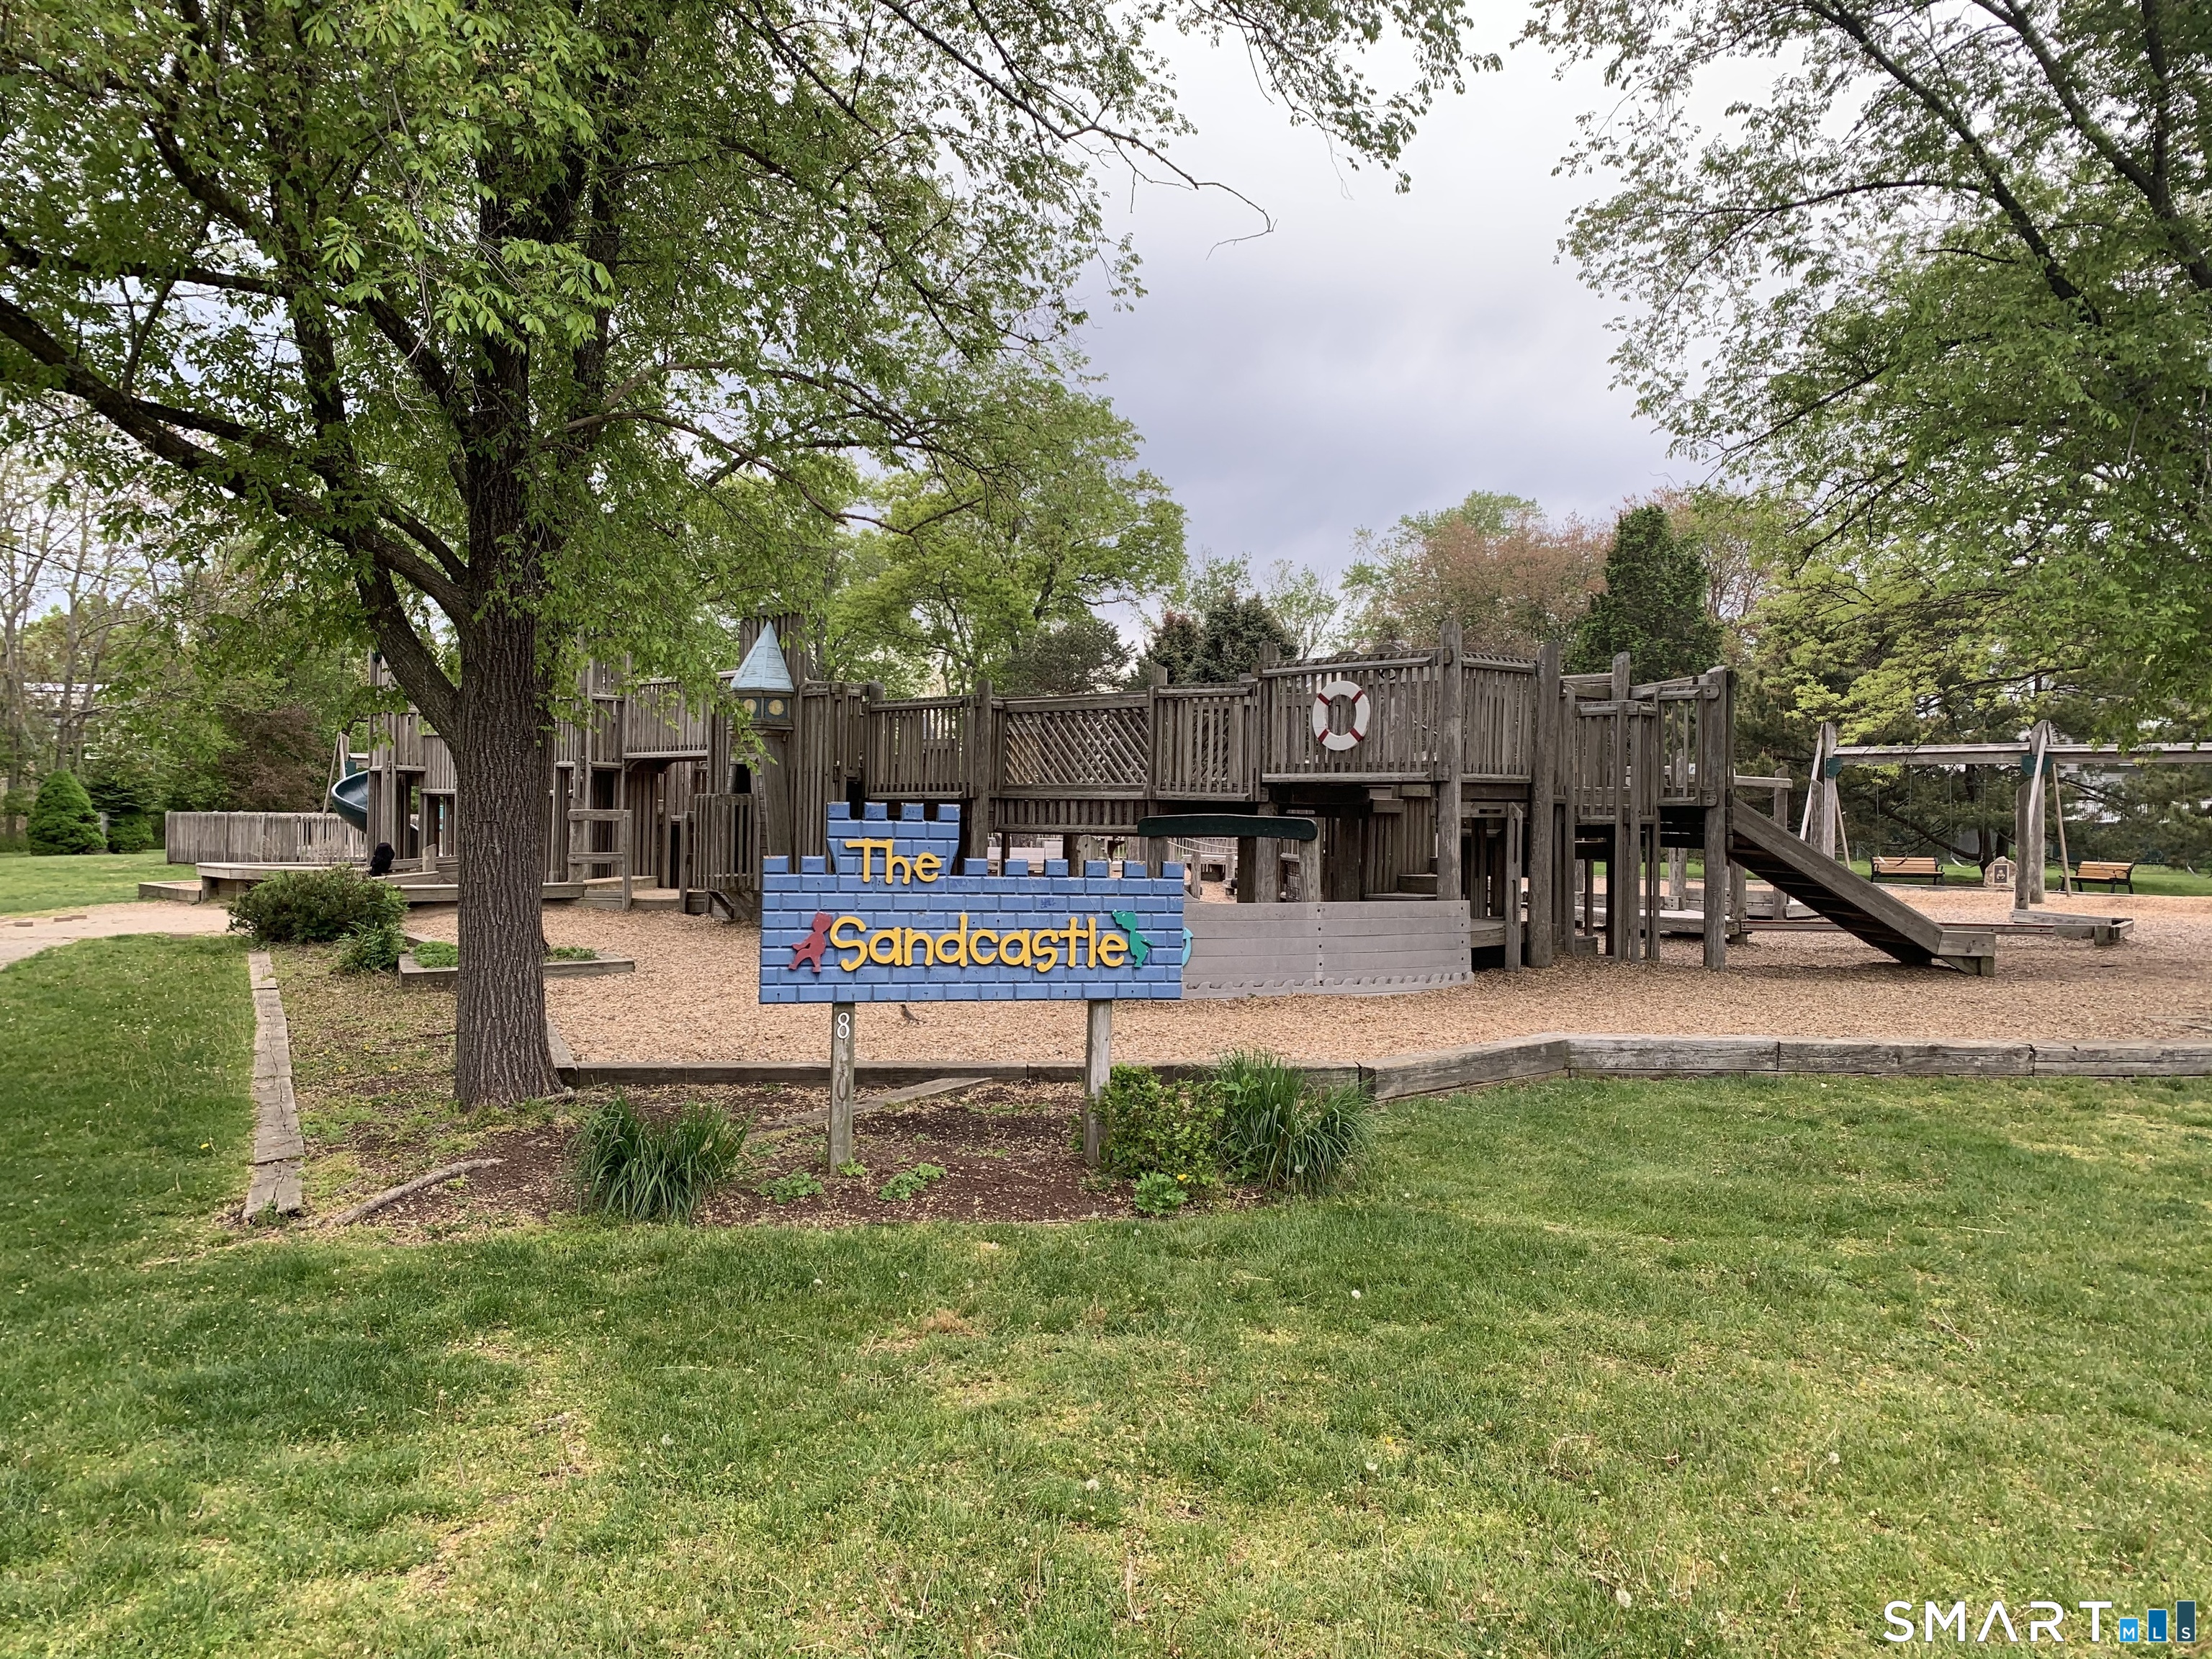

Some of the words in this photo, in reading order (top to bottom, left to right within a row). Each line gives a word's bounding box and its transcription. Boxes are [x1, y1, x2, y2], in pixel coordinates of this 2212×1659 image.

[845, 837, 942, 884] The
[830, 913, 1128, 972] Sandcastle
[837, 1012, 850, 1039] 8
